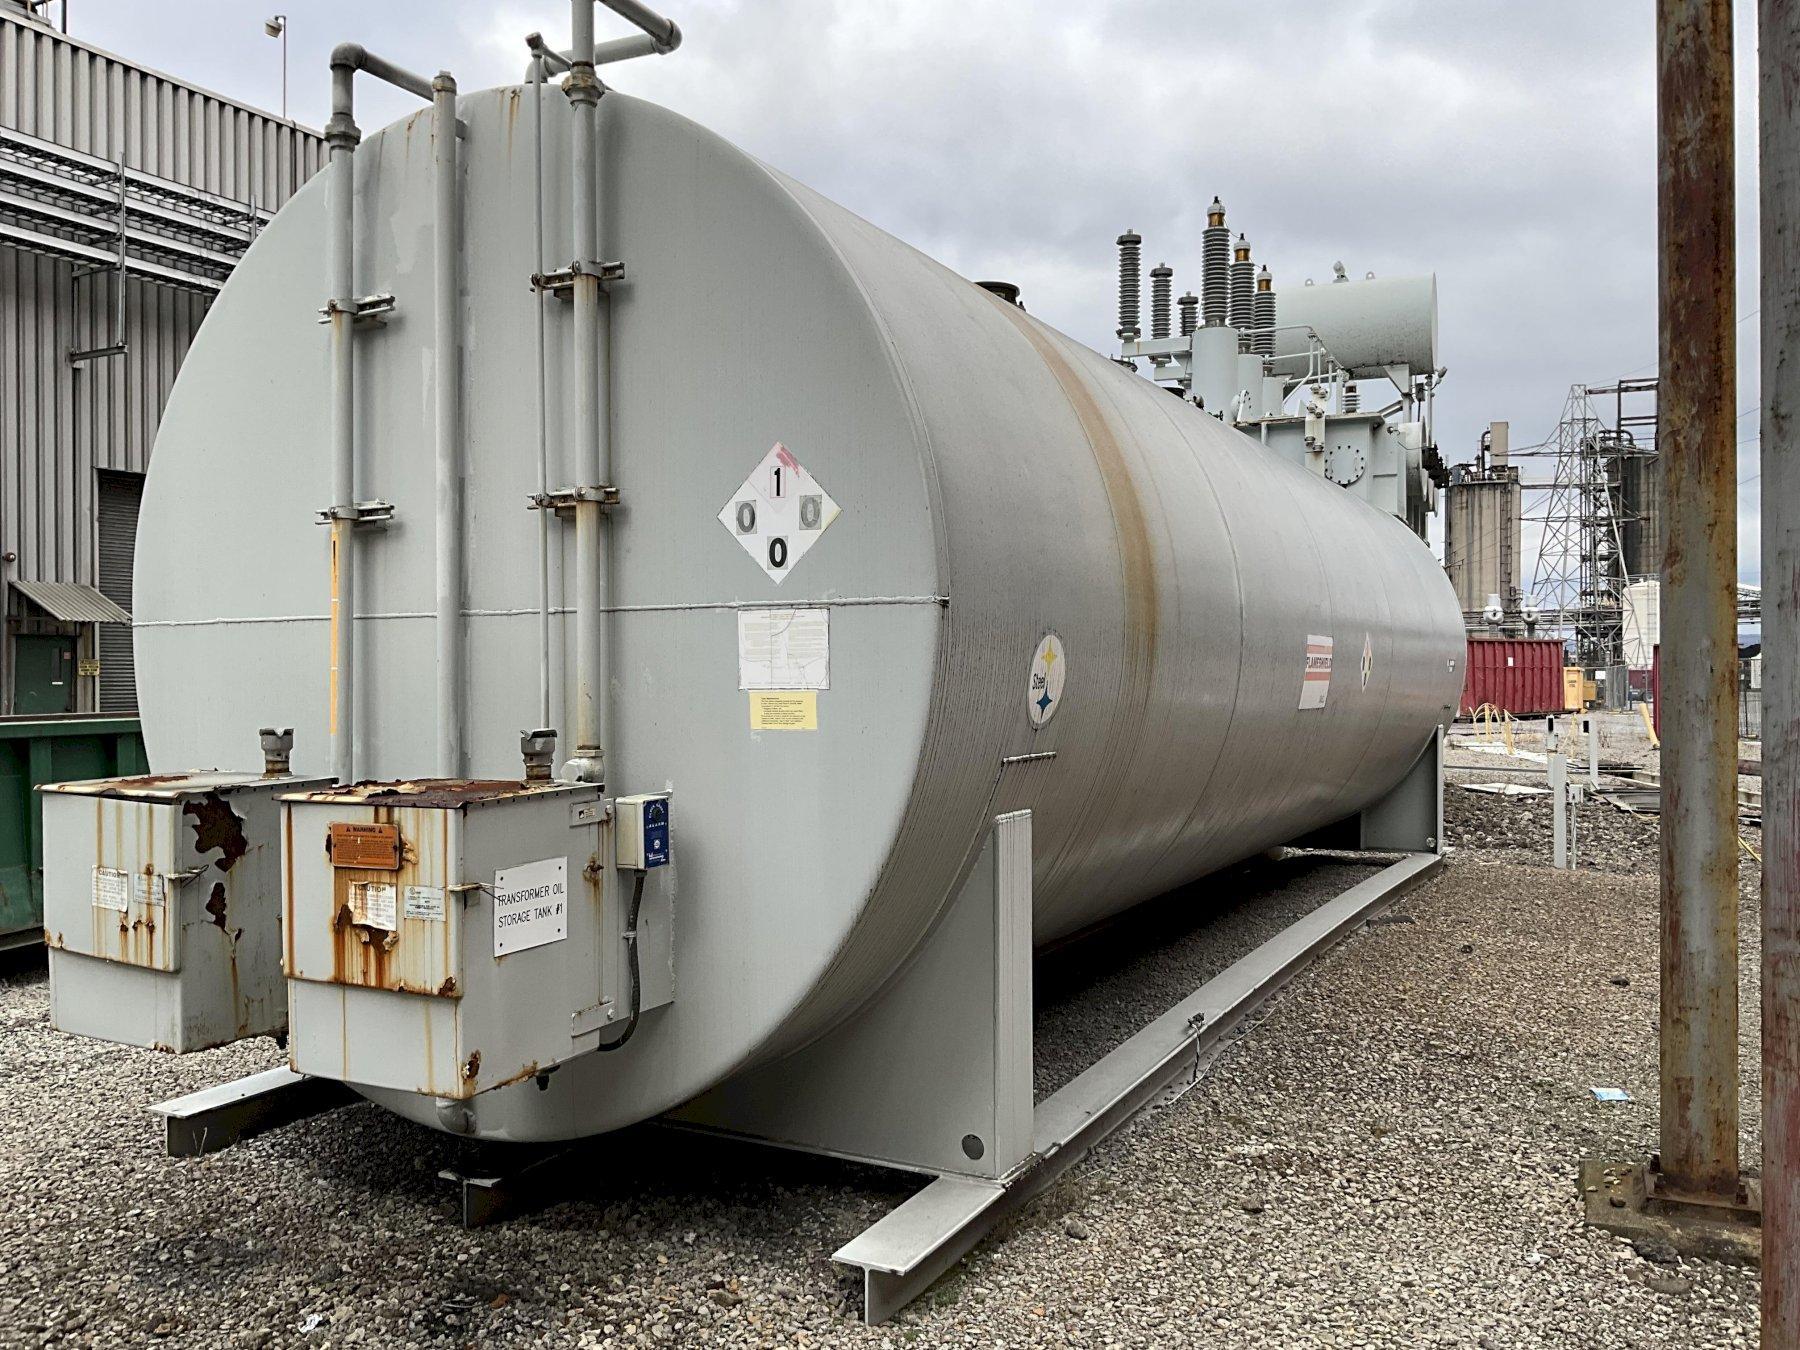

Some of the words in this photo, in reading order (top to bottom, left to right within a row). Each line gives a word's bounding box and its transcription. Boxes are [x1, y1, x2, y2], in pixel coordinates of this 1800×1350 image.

[774, 467, 781, 497] 1
[737, 502, 756, 533] 0
[800, 497, 820, 528] 0
[768, 537, 788, 568] 0
[358, 885, 387, 893] CUTION
[498, 885, 550, 907] TRANSFORMER
[553, 883, 565, 895] OIL
[498, 909, 531, 929] STORAGE
[534, 905, 553, 920] TANK
[556, 902, 563, 915] #1
